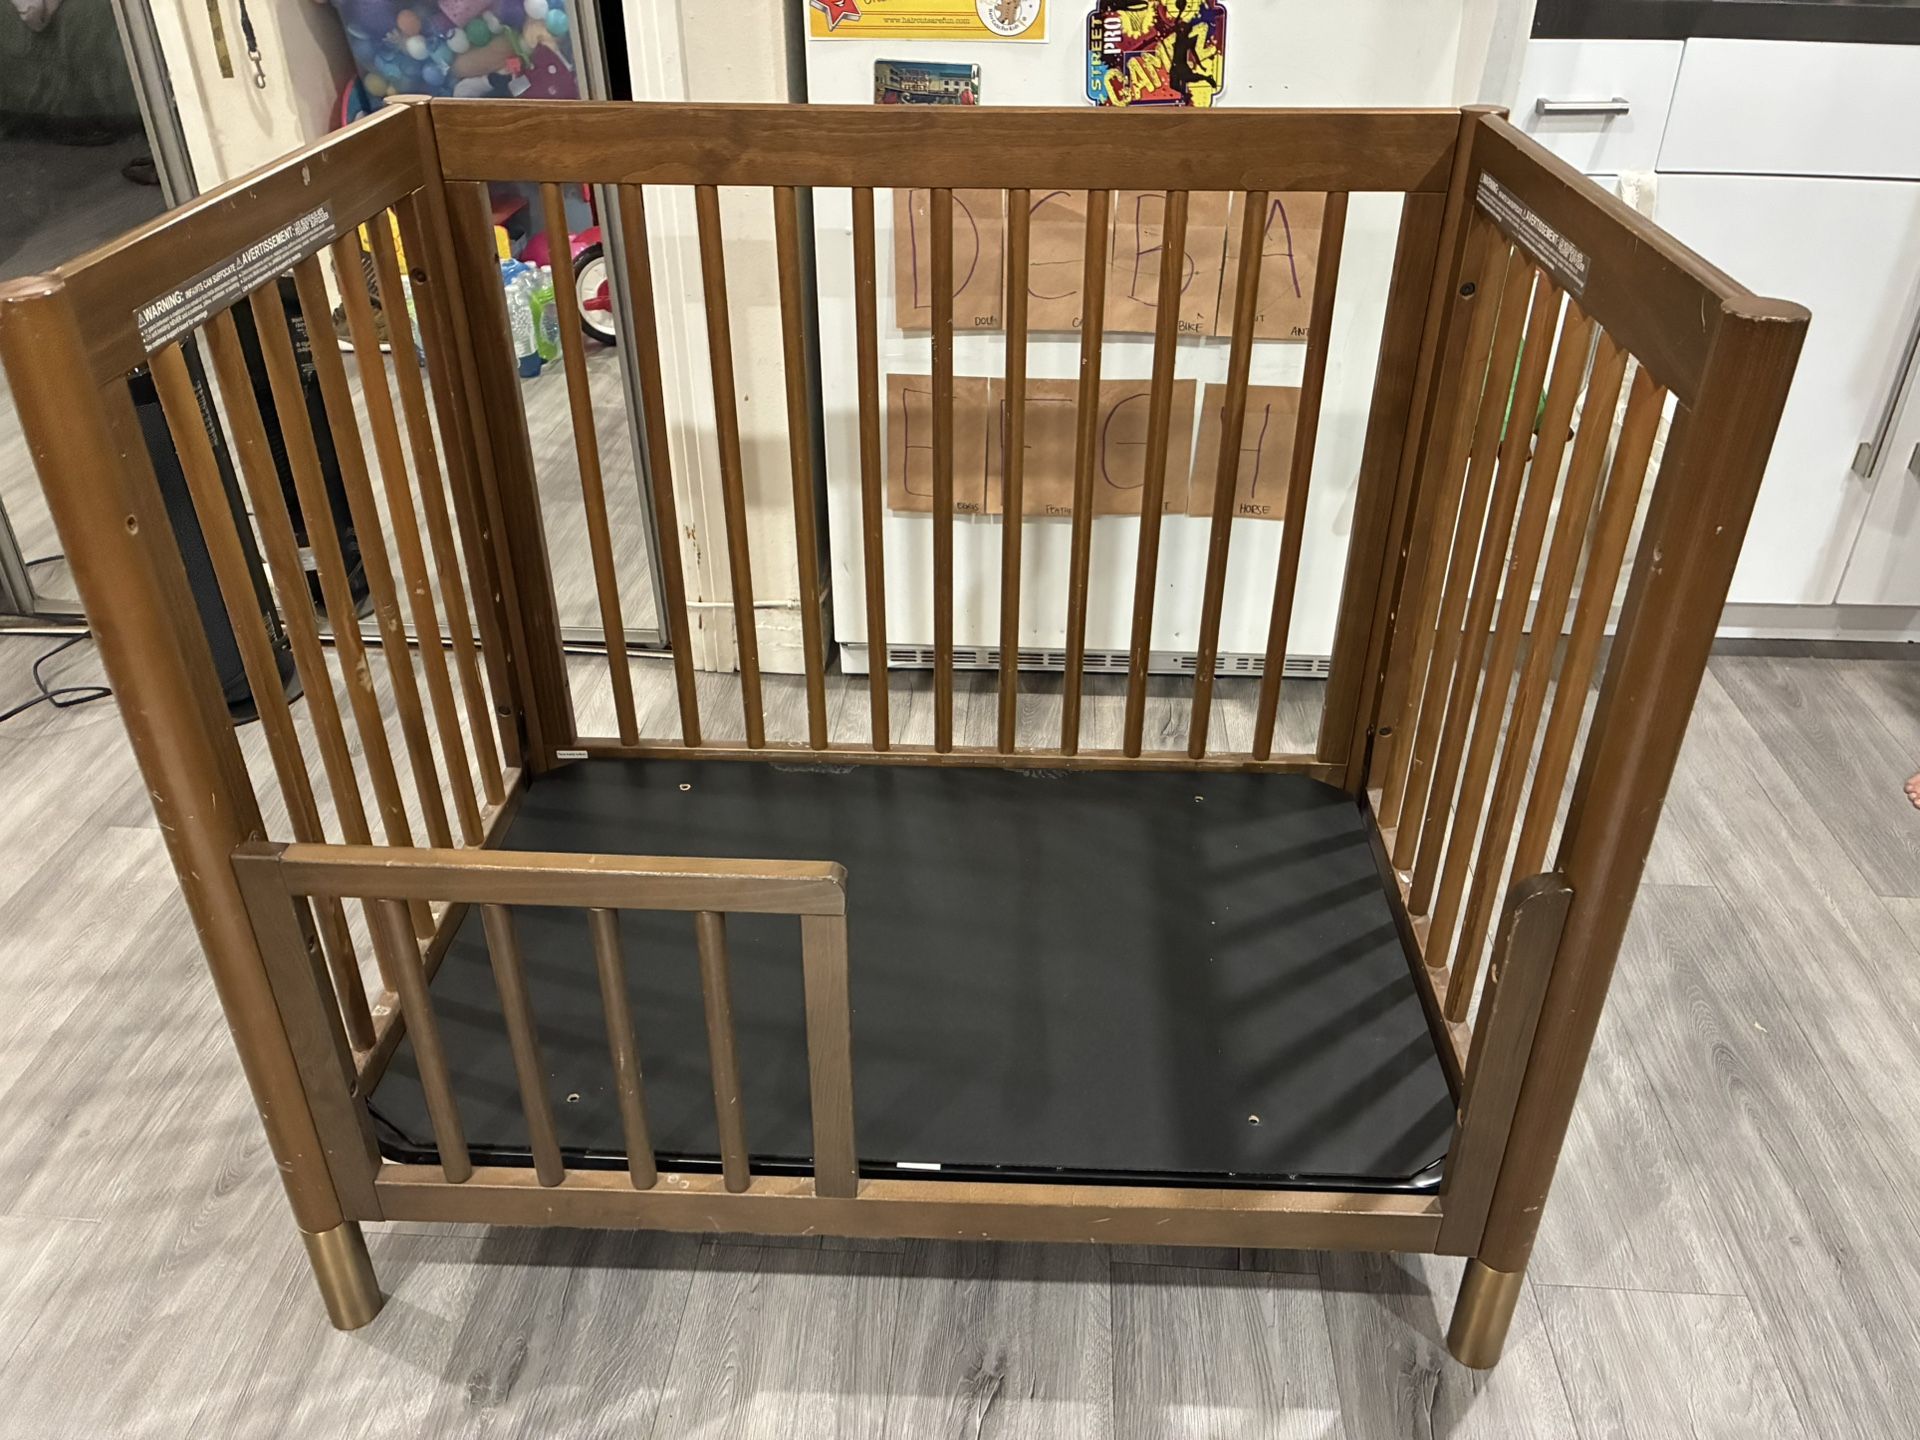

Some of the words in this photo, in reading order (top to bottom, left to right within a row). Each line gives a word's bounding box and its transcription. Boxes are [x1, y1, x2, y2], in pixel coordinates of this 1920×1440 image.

[1091, 15, 1103, 91] STREET
[1103, 17, 1122, 54] PRO
[242, 225, 295, 266] AVERTISSEMENT:
[1259, 199, 1302, 299] A
[142, 290, 185, 322] WARNING:
